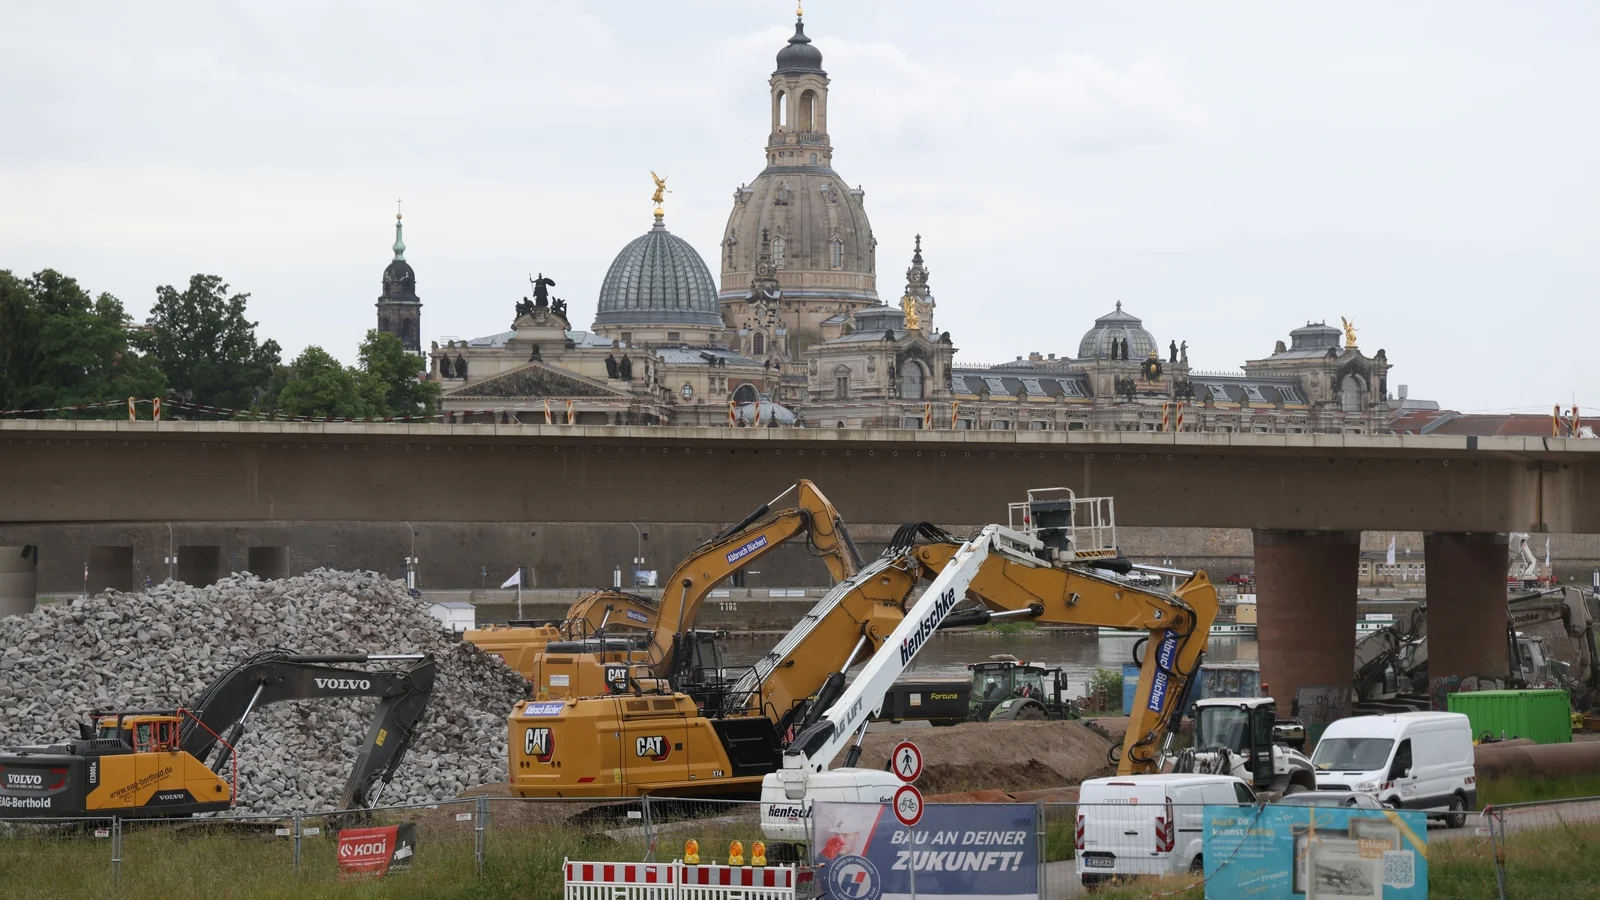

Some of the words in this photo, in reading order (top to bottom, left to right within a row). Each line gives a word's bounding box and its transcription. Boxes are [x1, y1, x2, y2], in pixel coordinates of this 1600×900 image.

[728, 547, 749, 563] Abbruch
[747, 536, 767, 552] Büchert
[900, 587, 956, 667] Hentschke
[314, 678, 371, 690] VOLVO
[608, 668, 626, 682] CAT
[1149, 672, 1168, 711] Büchert
[832, 722, 846, 744] JLG
[845, 696, 863, 725] LIFT
[525, 728, 549, 755] CAT
[636, 736, 663, 757] CAT
[8, 774, 42, 784] VOLVO
[109, 766, 173, 799] www.eag-berthold.de
[0, 796, 51, 808] EAG-Berthold
[890, 830, 929, 845] BAU
[931, 831, 959, 845] AN
[961, 831, 1027, 846] DEINER
[1212, 828, 1244, 836] kannst
[891, 851, 1023, 871] ZUKUNFT!
[1261, 870, 1289, 882] Freude
